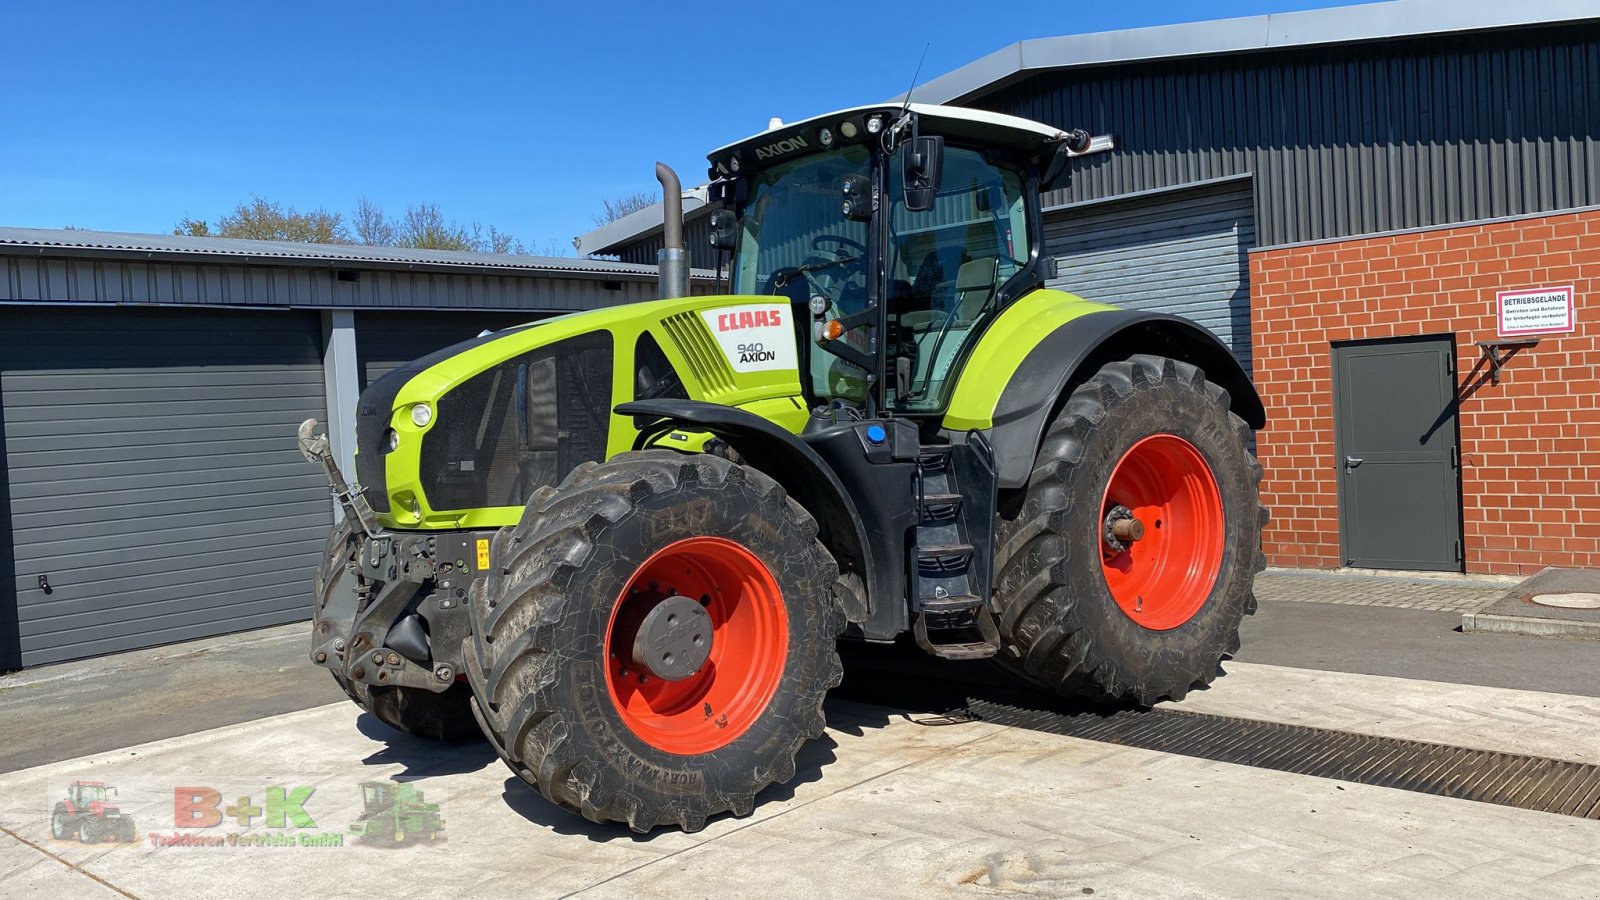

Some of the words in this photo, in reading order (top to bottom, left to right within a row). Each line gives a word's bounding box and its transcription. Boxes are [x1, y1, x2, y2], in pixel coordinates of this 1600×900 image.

[755, 135, 808, 160] AXION
[718, 310, 781, 332] CLAAS
[737, 342, 763, 354] 940
[739, 351, 775, 363] AXION
